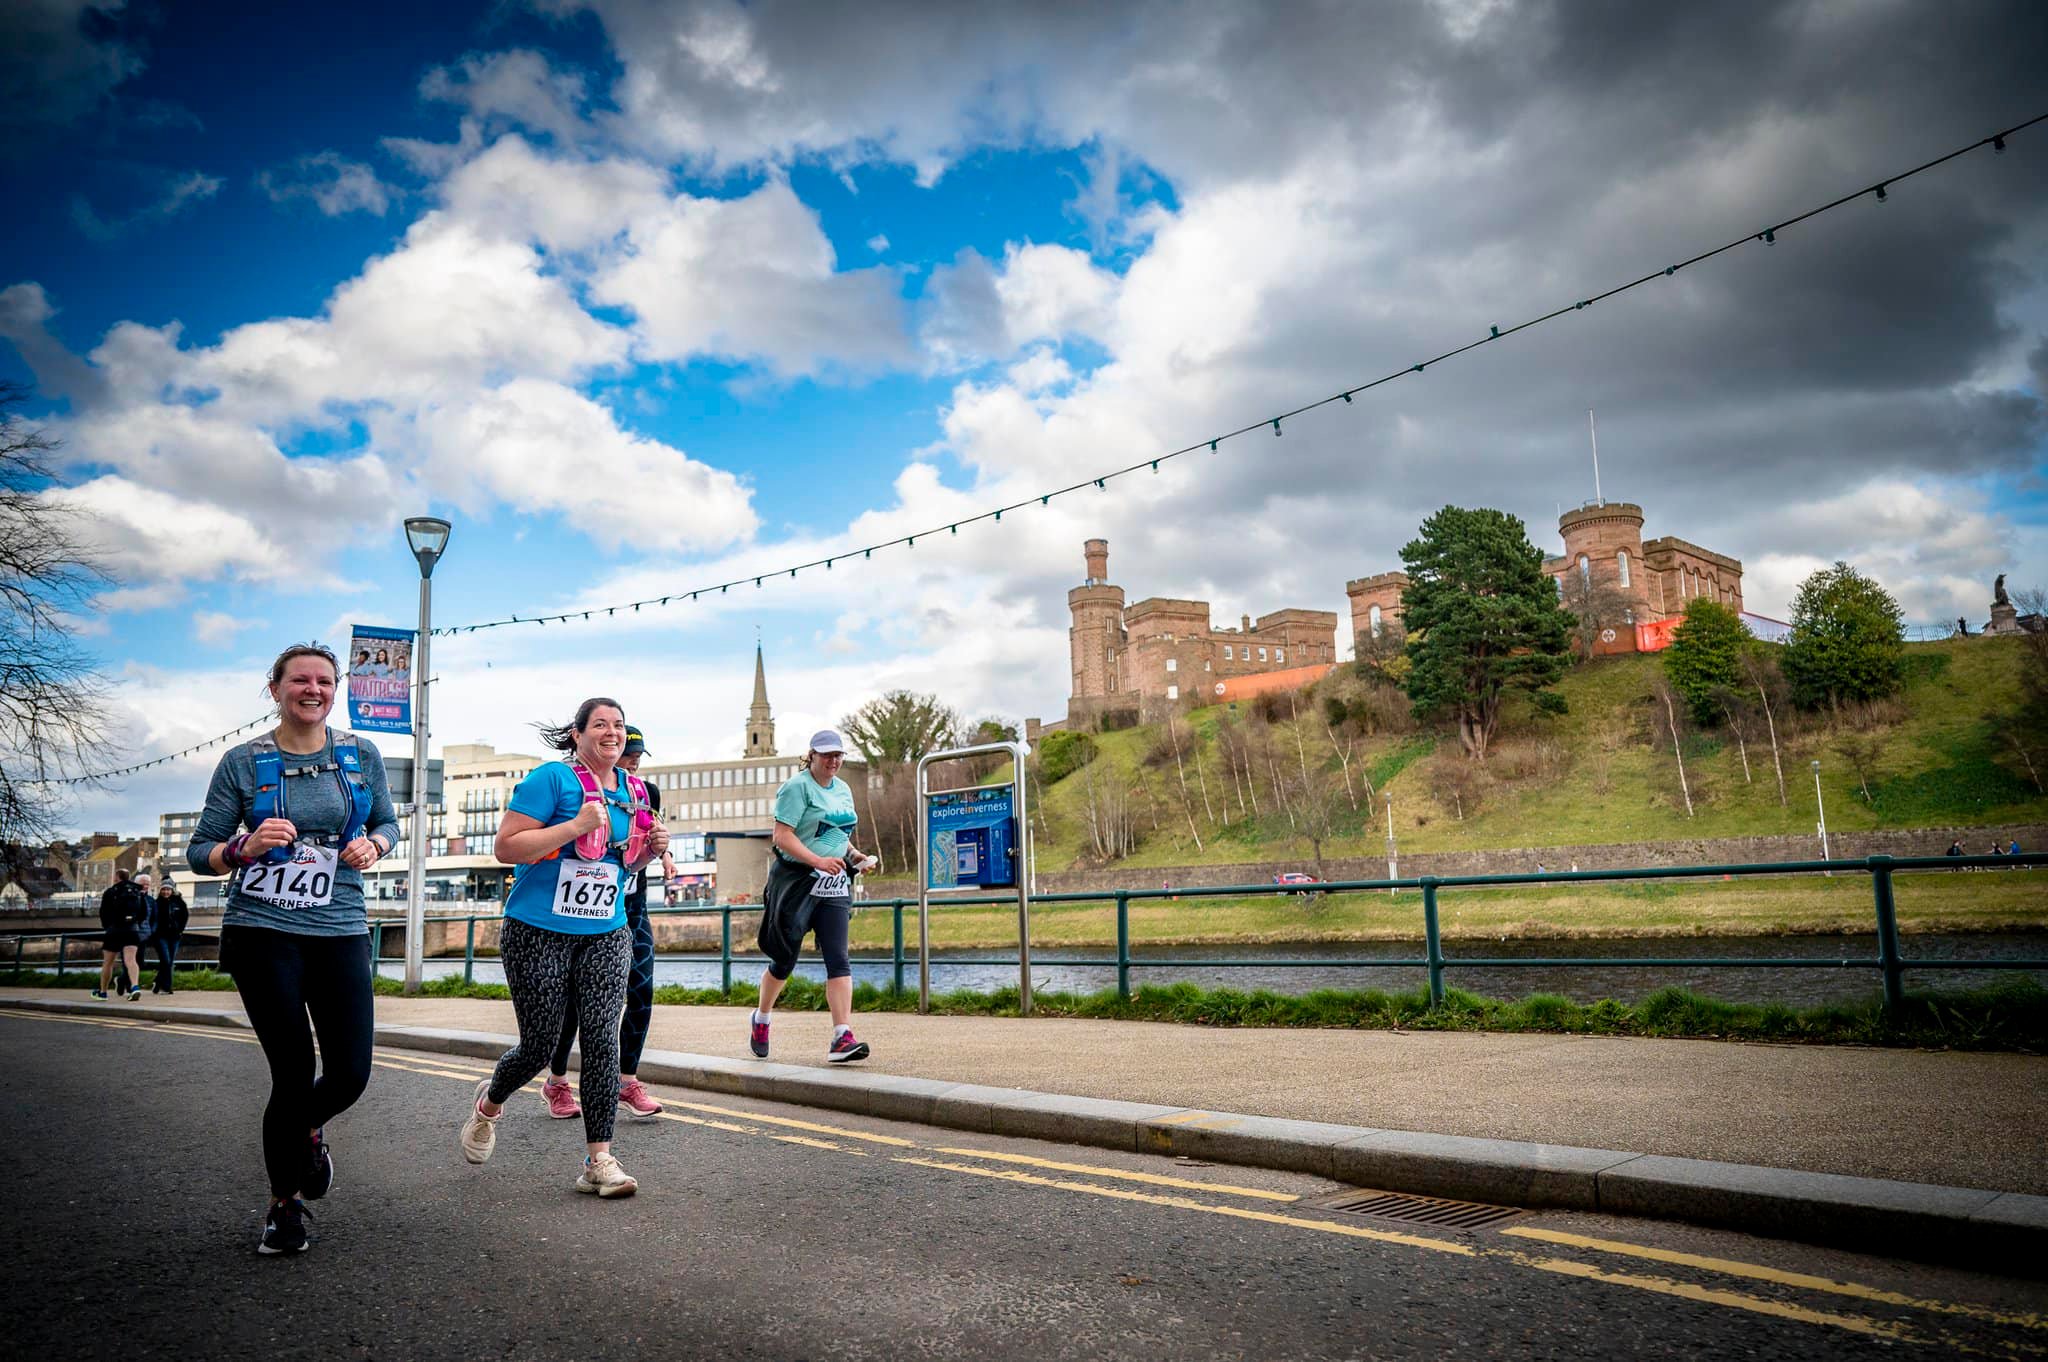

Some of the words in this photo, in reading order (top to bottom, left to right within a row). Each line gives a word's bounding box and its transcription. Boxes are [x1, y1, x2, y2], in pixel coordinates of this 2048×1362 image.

[932, 802, 1008, 819] exploreinverness
[246, 867, 331, 898] 2140
[818, 875, 847, 889] 1049
[561, 880, 617, 907] 1673
[560, 905, 609, 917] INVERNESS
